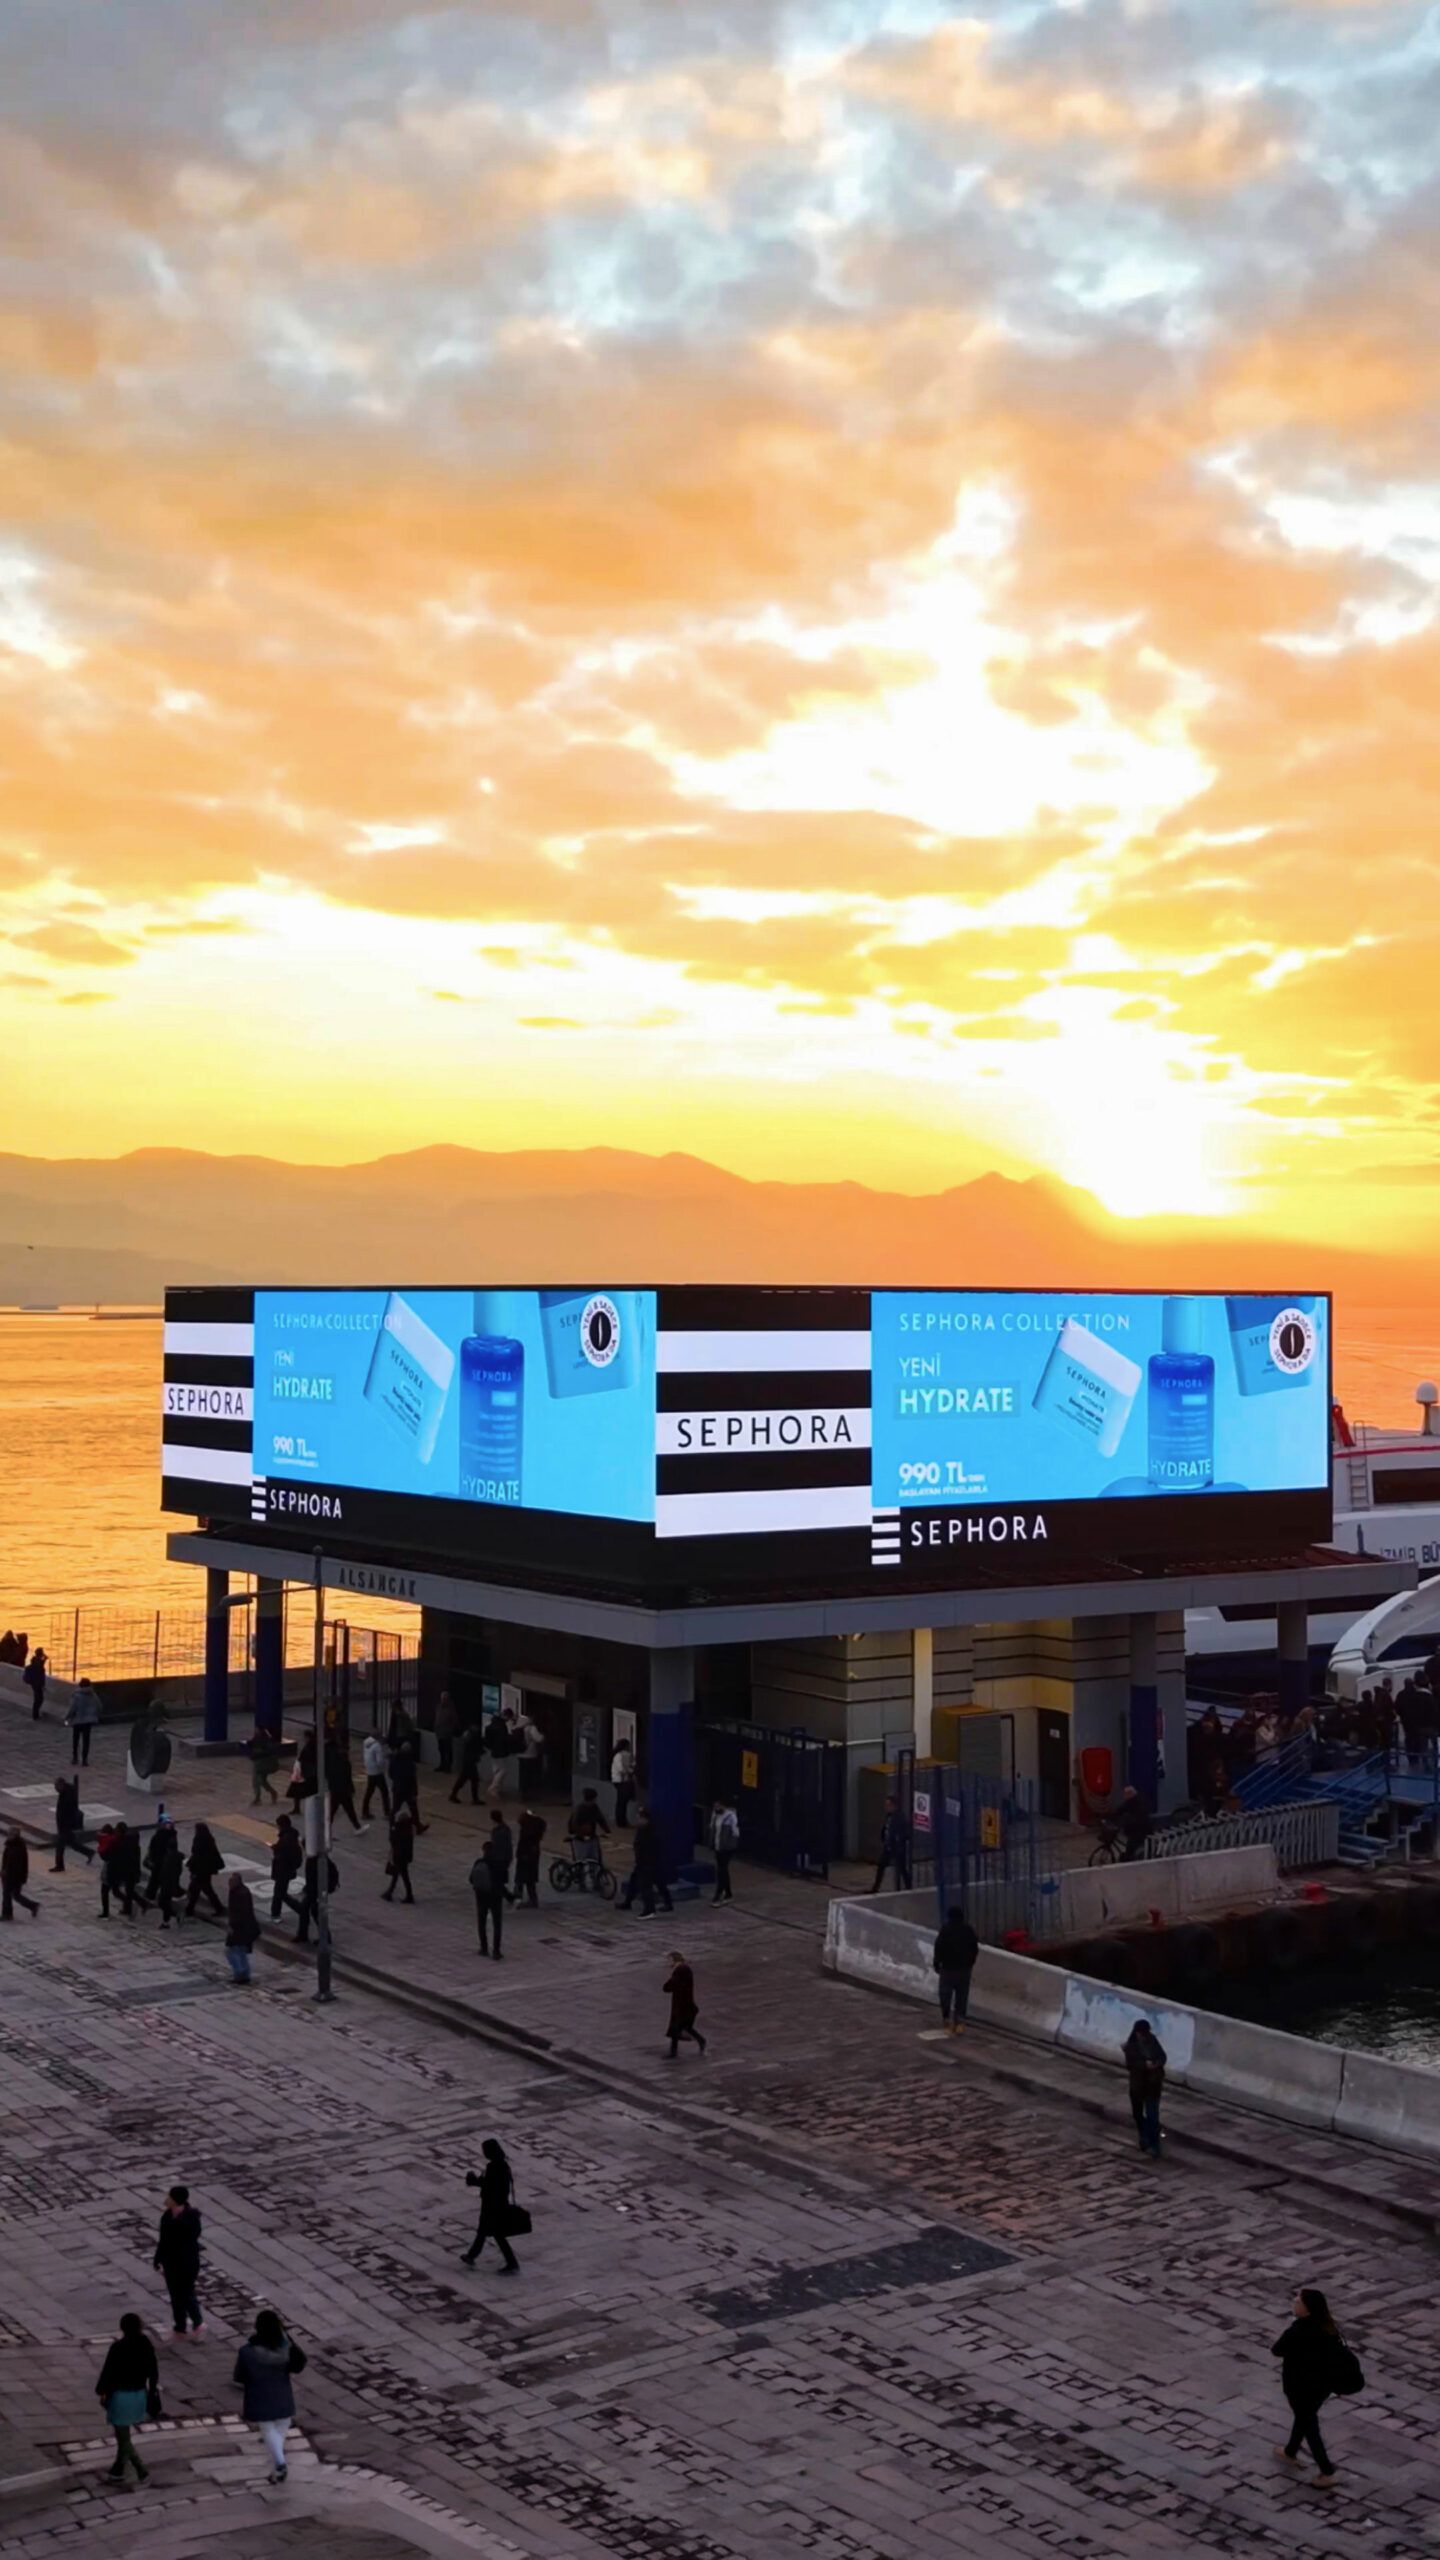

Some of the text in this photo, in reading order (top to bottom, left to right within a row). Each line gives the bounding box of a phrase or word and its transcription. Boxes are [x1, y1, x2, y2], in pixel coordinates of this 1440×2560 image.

[273, 1313, 402, 1331] SEPHORA COLLECTION
[900, 1313, 1130, 1331] SEPHORA COLLECTION
[390, 1349, 424, 1390] SEPHORA
[472, 1369, 512, 1382] SEPHORA
[899, 1352, 941, 1377] YENİ
[273, 1376, 332, 1399] HYDRATE
[1066, 1366, 1106, 1399] SEPHORA
[1161, 1378, 1203, 1389] SEPHORA
[168, 1387, 244, 1415] SEPHORA
[900, 1388, 1013, 1414] HYDRATE
[677, 1415, 852, 1448] SEPHORA
[273, 1436, 293, 1456] 990
[899, 1462, 940, 1485] 990
[1151, 1456, 1211, 1478] HYDRATE
[462, 1475, 520, 1501] HYDRATE
[270, 1488, 342, 1519] SEPHORA
[911, 1515, 1048, 1546] SEPHORA
[339, 1567, 416, 1597] ALSANCAK
